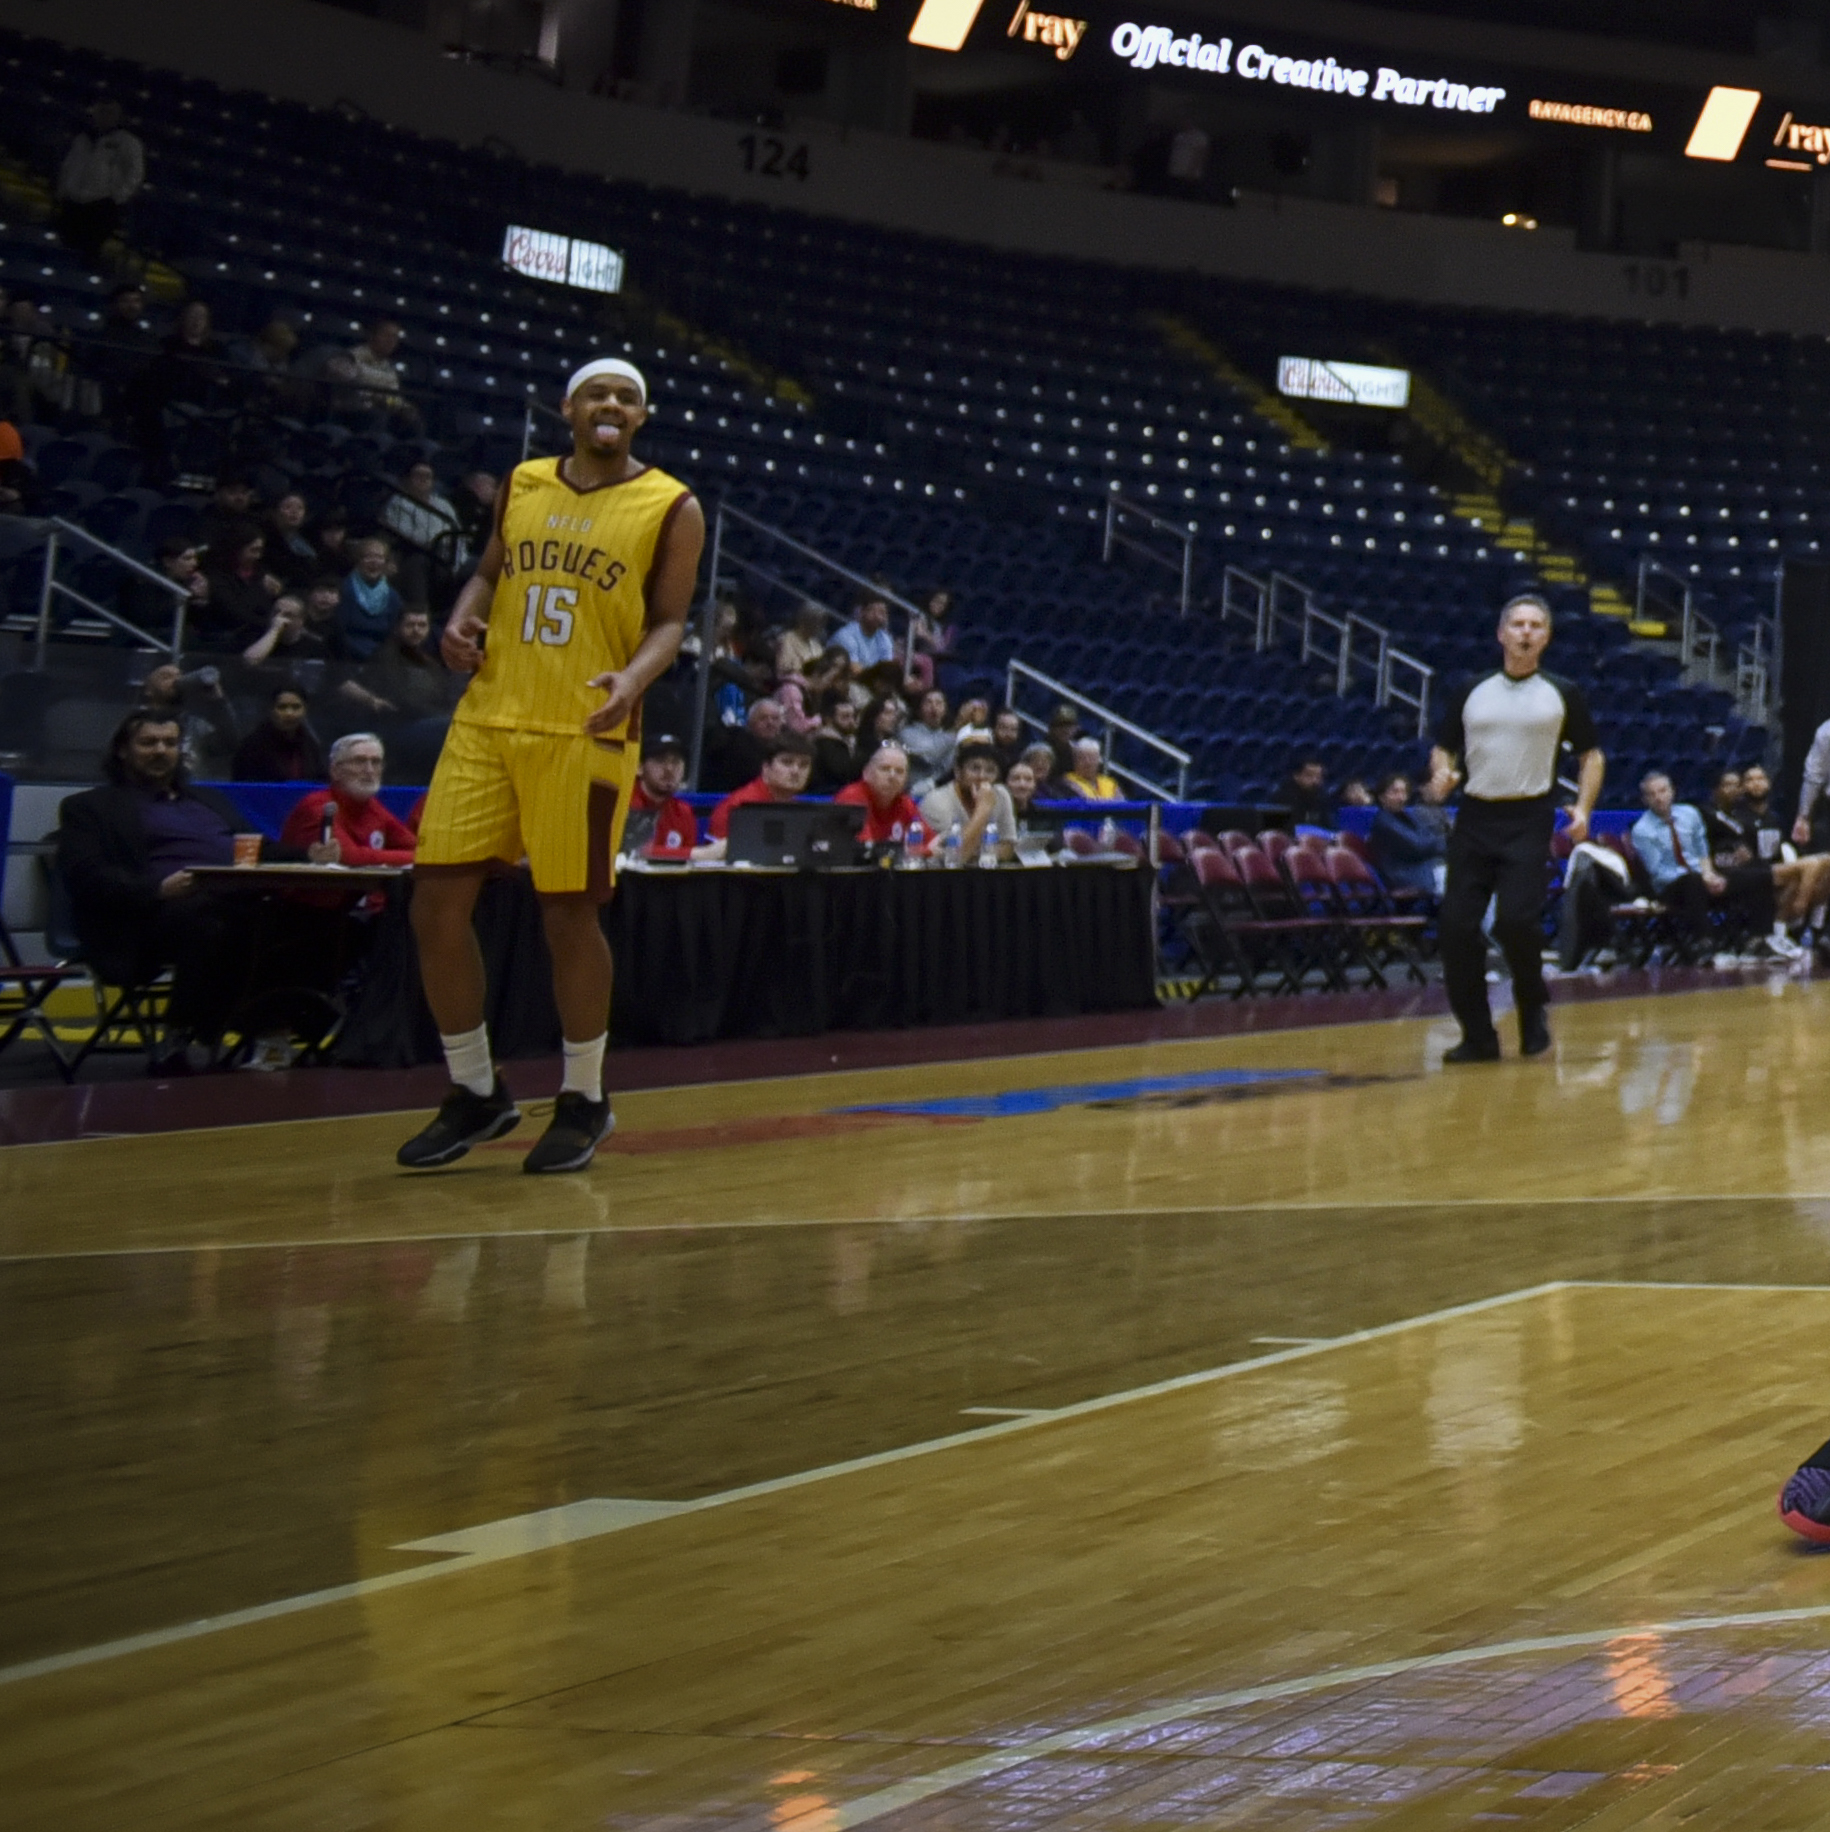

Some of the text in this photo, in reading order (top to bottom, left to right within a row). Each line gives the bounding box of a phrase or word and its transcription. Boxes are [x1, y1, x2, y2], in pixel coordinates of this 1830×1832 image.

[1110, 22, 1507, 113] Official Creative Partner
[738, 134, 810, 182] 124
[1622, 264, 1689, 300] 101
[547, 515, 592, 533] NFLD
[503, 539, 626, 592] ROGUES
[521, 583, 579, 647] 15
